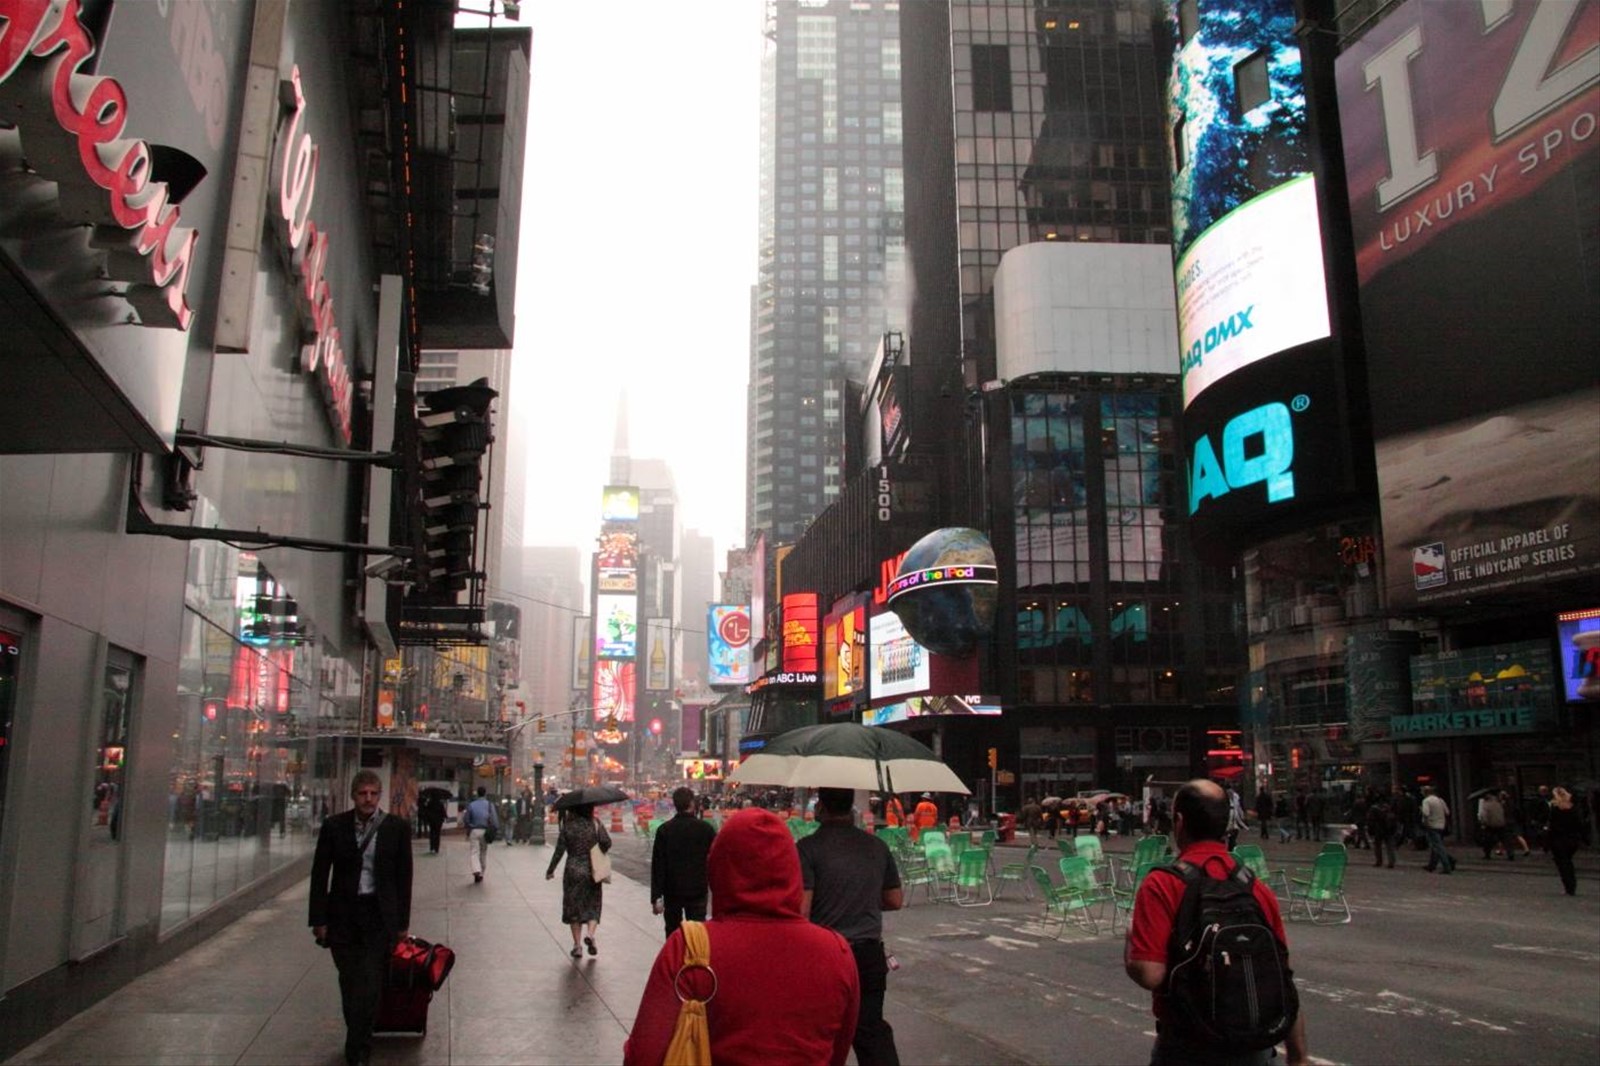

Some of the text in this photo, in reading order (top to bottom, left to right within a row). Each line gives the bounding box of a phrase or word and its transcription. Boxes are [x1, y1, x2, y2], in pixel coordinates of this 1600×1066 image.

[0, 0, 198, 331] reens
[1379, 112, 1596, 251] LUXURY SPO
[1204, 304, 1254, 355] OMX
[878, 466, 890, 521] 1500
[1450, 524, 1570, 563] OFFICIAL APPAREL OF
[1453, 568, 1472, 582] THE
[1532, 544, 1576, 566] SERIES
[874, 550, 909, 604] JV
[909, 575, 919, 585] of
[922, 571, 943, 582] the
[944, 567, 974, 579] iPod
[777, 674, 795, 684] ABC
[796, 673, 817, 683] Live
[1390, 707, 1533, 733] MARKETSITE
